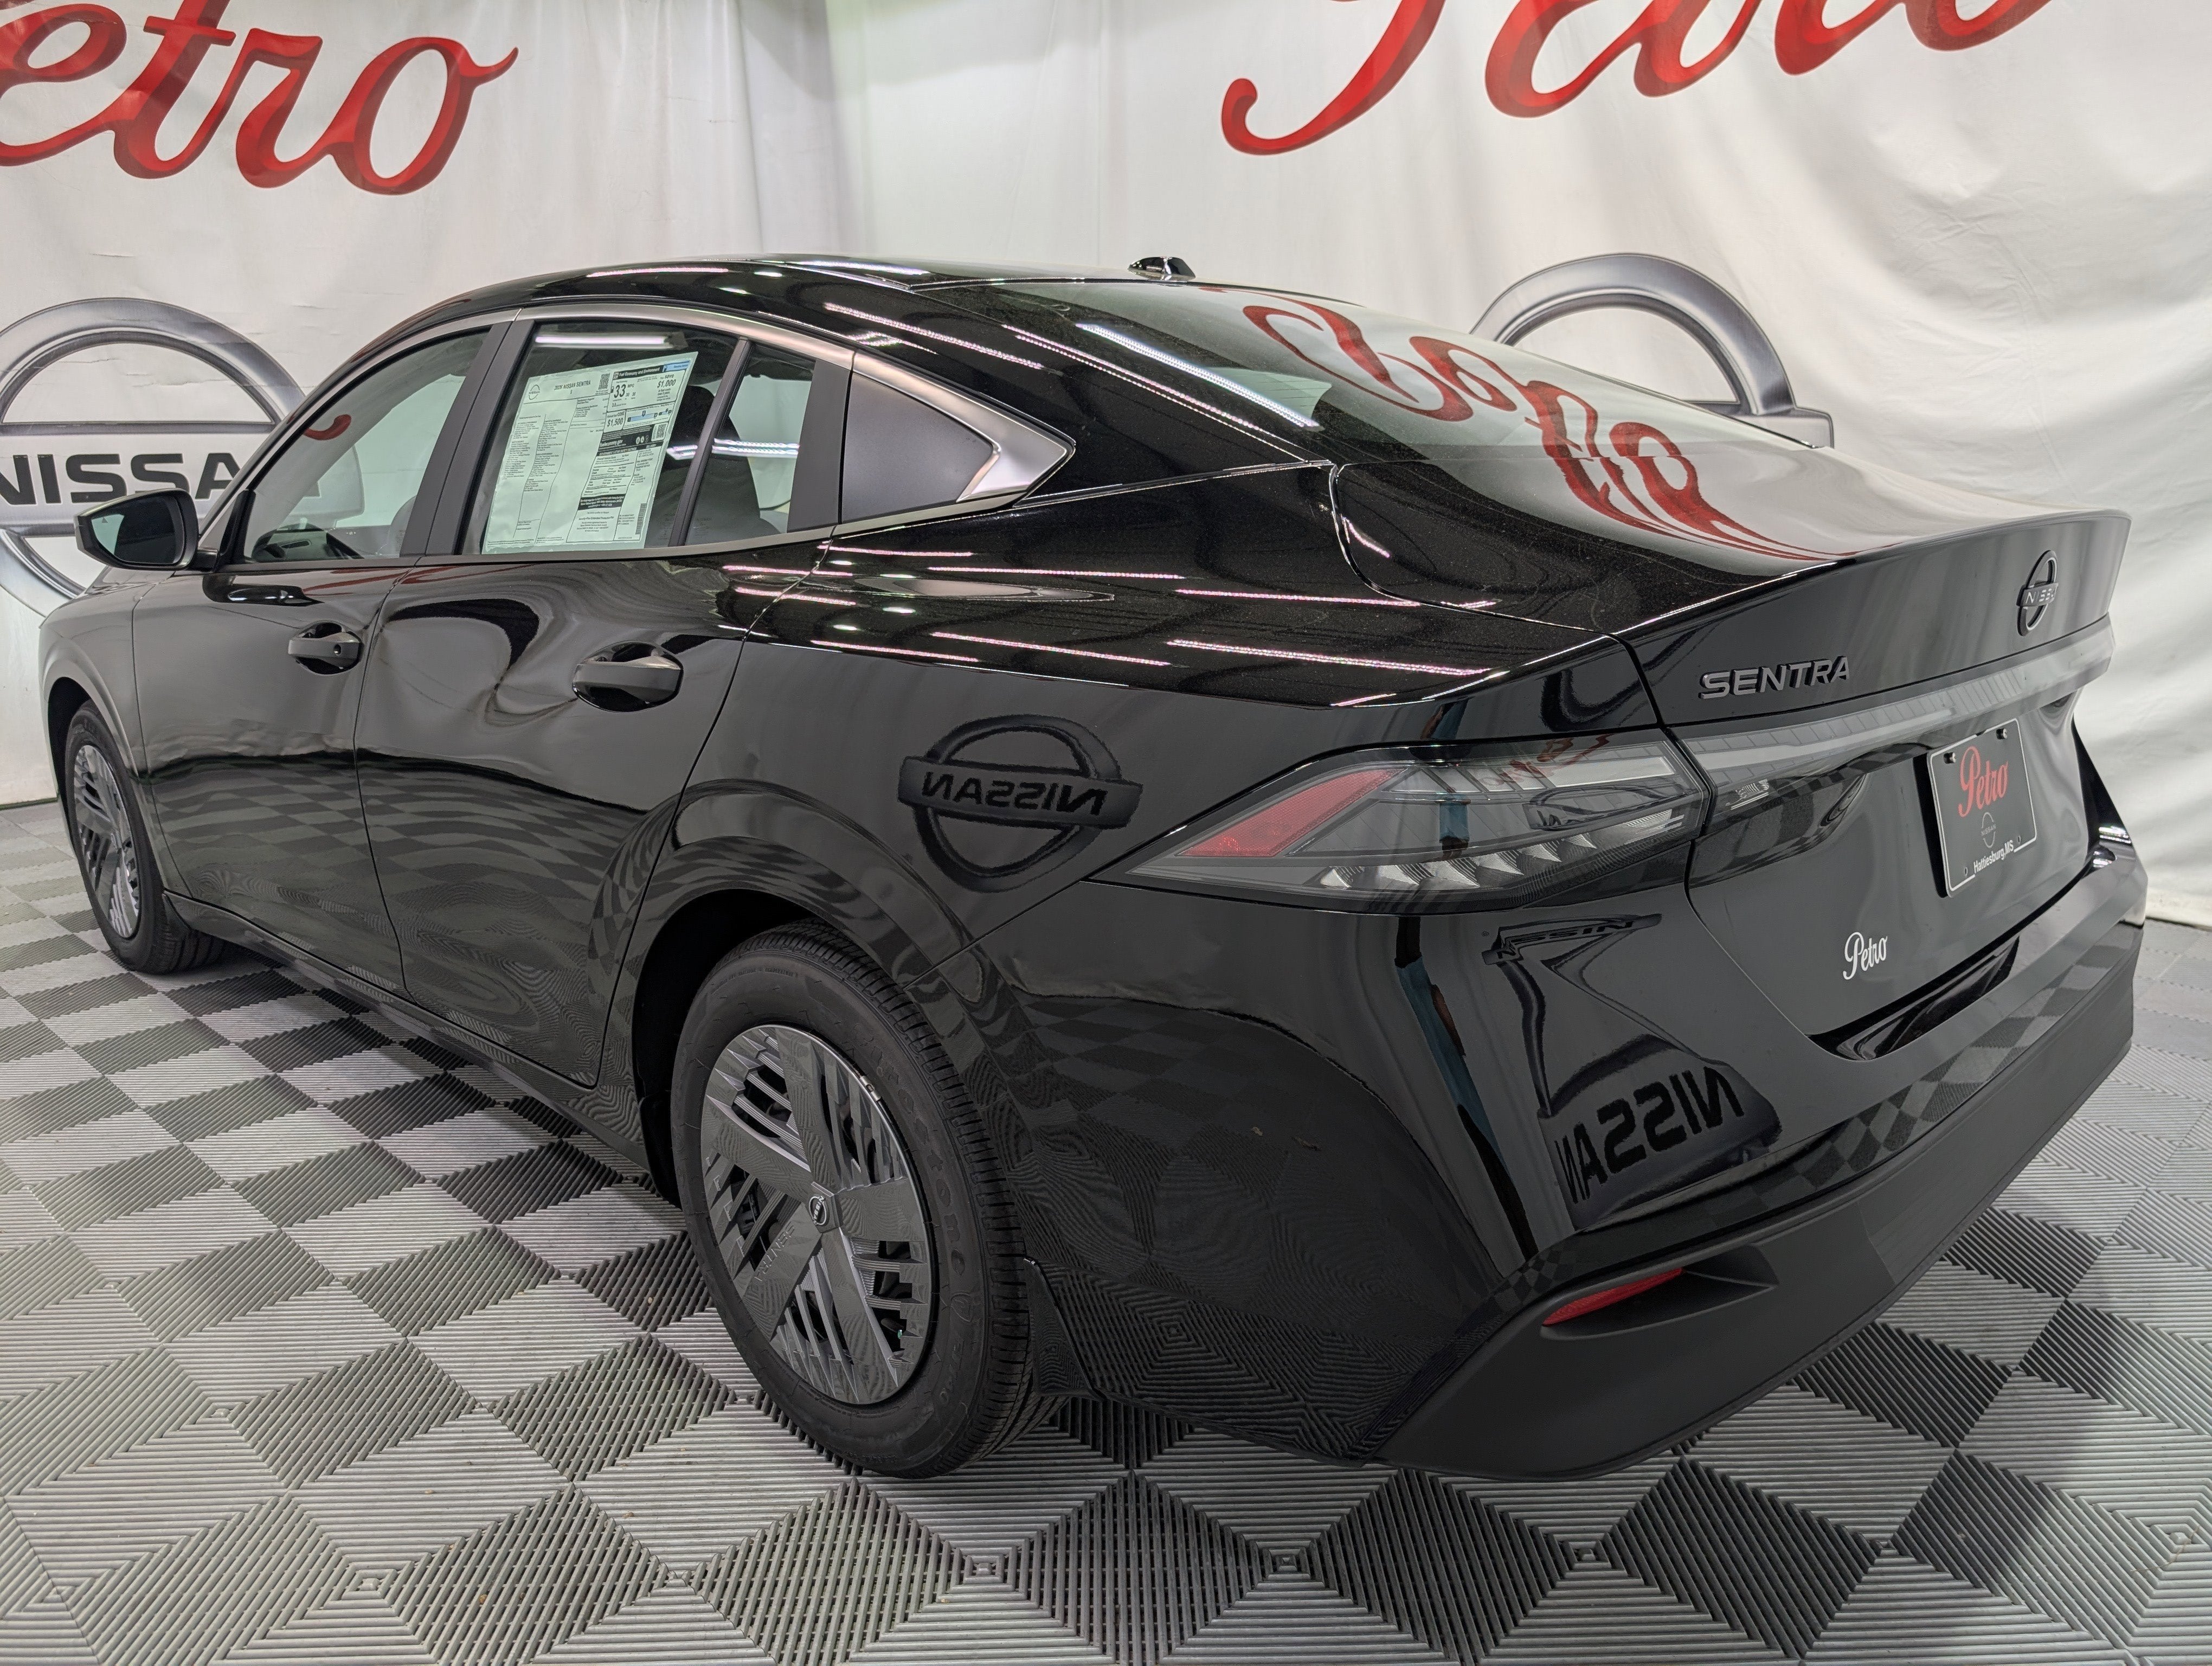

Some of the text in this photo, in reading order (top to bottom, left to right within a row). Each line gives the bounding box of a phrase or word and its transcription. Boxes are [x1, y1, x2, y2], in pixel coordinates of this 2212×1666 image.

[0, 0, 519, 196] etro
[614, 384, 626, 399] 33
[657, 379, 676, 388] $1,000
[607, 418, 623, 427] $1,500
[1700, 655, 1850, 700] SENTRA
[1957, 745, 2009, 817] Petro
[1843, 930, 1888, 980] Petro
